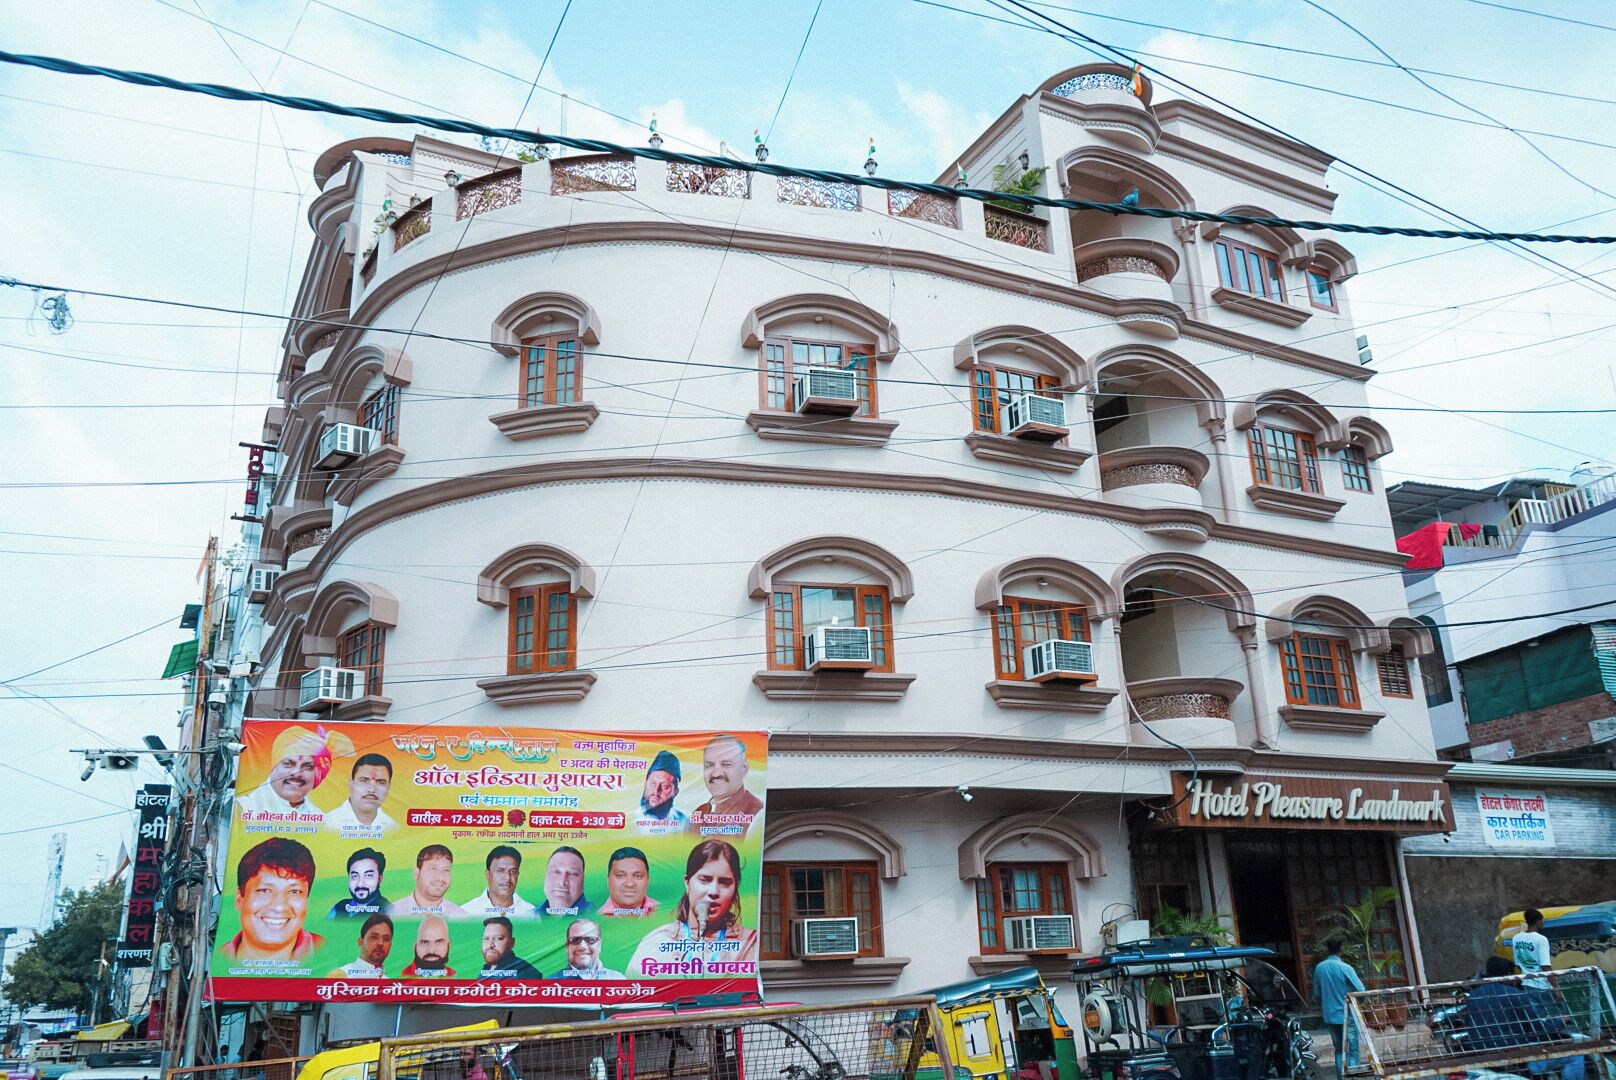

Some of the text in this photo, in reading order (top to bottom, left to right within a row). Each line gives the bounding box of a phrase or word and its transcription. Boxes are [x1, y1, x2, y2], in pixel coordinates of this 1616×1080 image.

[560, 758, 647, 770] ए अदब की पेशकश
[414, 766, 624, 792] ऑल इन्डिया मुशायरा
[136, 790, 170, 807] होटल
[460, 792, 578, 808] एवं सम्मान समारोह
[1186, 778, 1446, 824] Hotel Pleasure Landmark
[1480, 793, 1503, 810] होटल
[257, 812, 283, 822] मोहन
[285, 812, 297, 822] जी
[300, 813, 323, 822] यादव
[451, 814, 502, 825] 17-8-2025
[582, 816, 605, 826] 9:30
[608, 814, 624, 826] बजे
[1486, 816, 1508, 828] कार
[140, 816, 166, 839] श्री
[1494, 829, 1545, 841] CAR PARKING
[659, 939, 705, 952] आमंत्रित
[117, 948, 152, 961] शरणम्
[641, 957, 756, 977] हिमांशी बाबरा
[316, 981, 657, 1000] मुस्लिम नौजवान कमेटी कोट मोहल्ला उज्जैन
